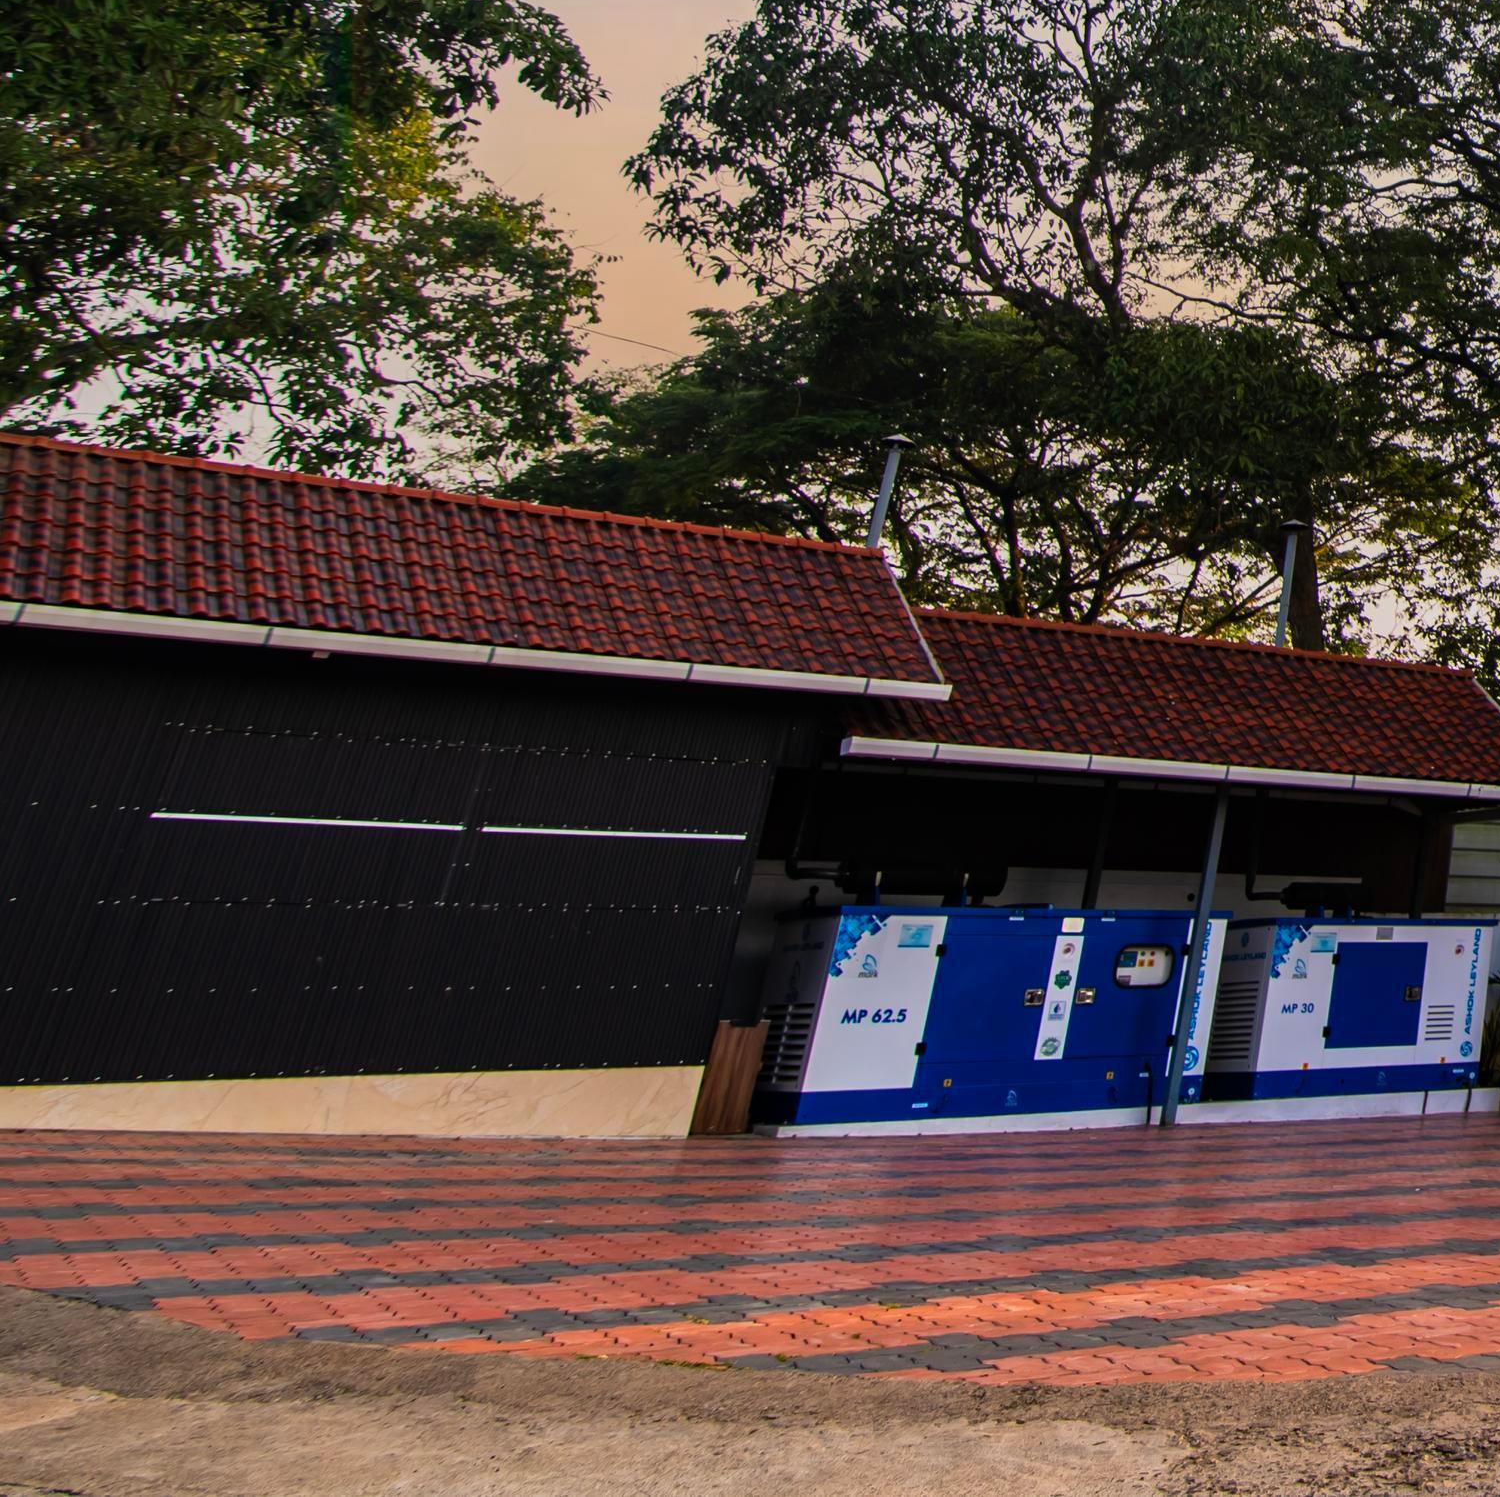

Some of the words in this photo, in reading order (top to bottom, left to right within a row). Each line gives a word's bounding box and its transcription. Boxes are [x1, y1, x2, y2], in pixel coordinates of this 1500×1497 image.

[1469, 927, 1482, 987] LEYLAND
[840, 1008, 869, 1024] MP
[871, 1008, 908, 1024] 62.5
[1281, 1003, 1299, 1015] MP
[1300, 1002, 1315, 1014] 30
[1464, 990, 1475, 1035] ASHOK
